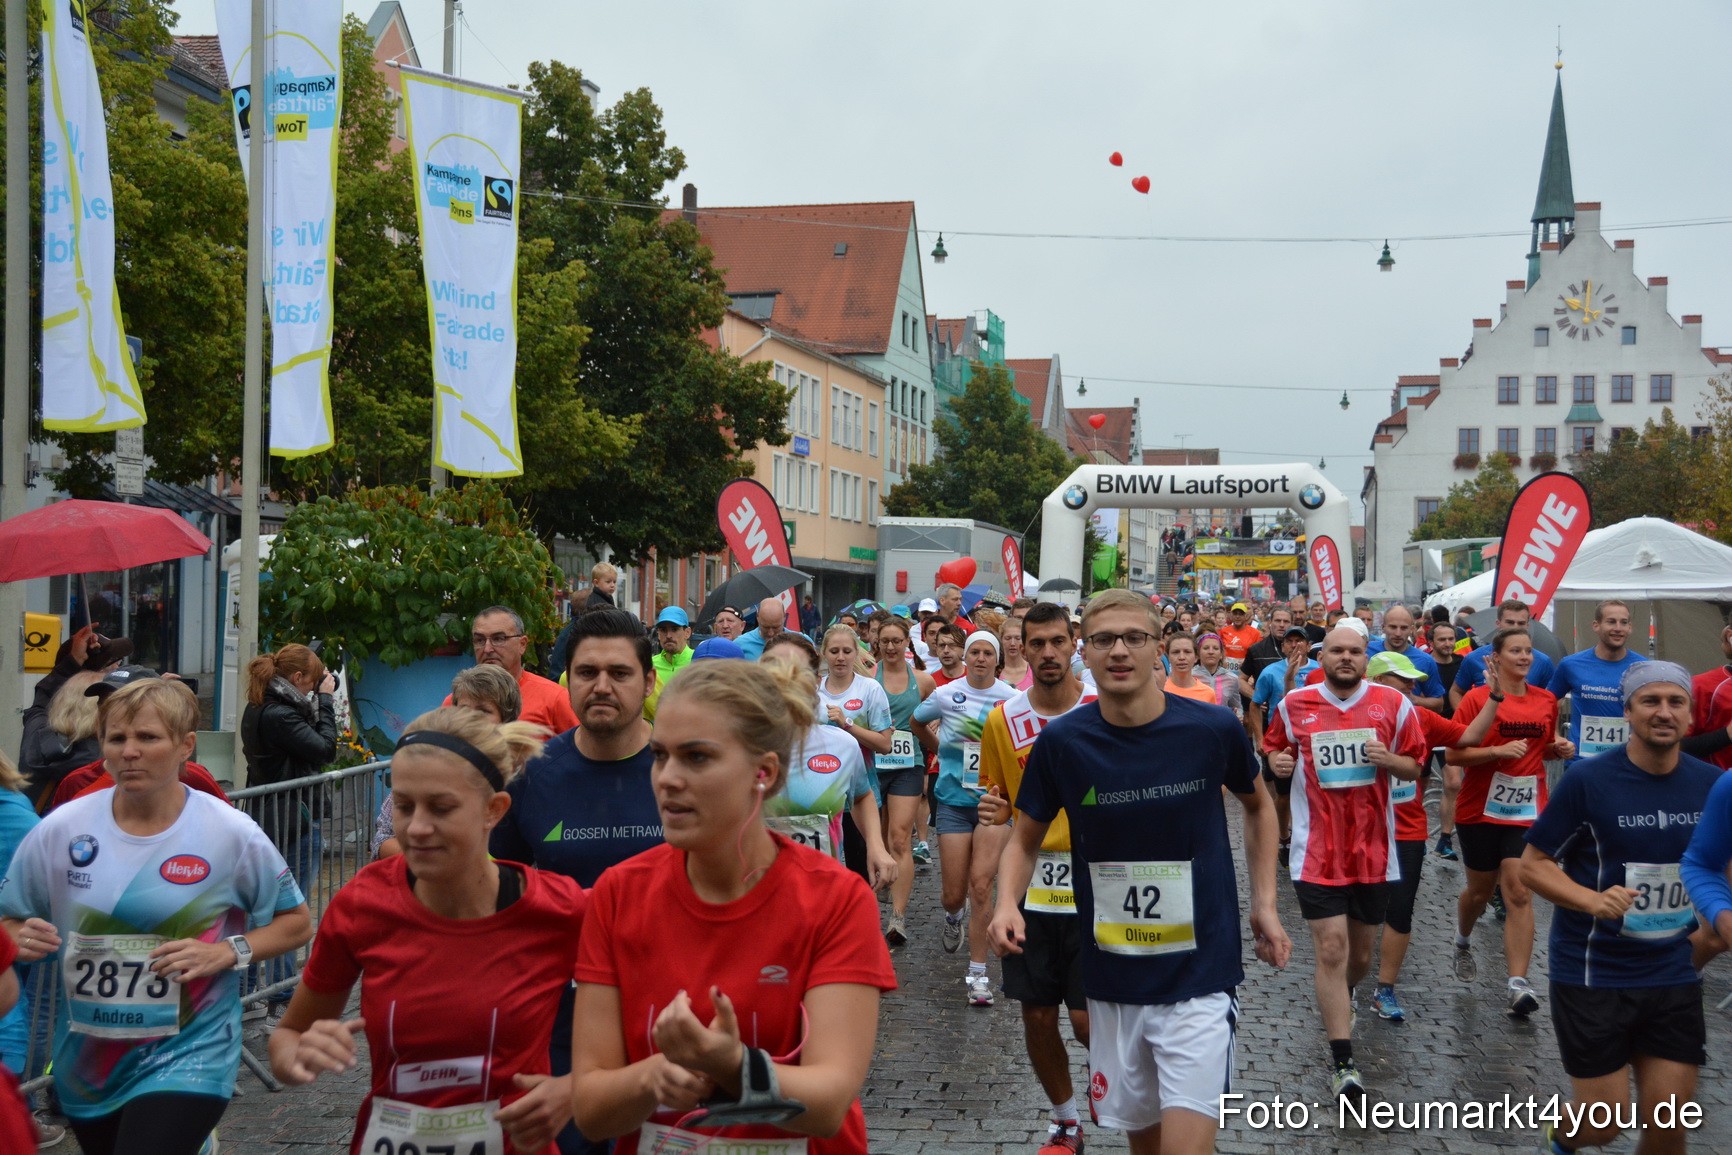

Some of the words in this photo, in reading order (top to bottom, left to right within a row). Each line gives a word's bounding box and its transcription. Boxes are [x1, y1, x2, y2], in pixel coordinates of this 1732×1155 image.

[1096, 473, 1163, 494] BMW
[1169, 473, 1290, 498] Laufsport
[1501, 492, 1578, 606] REWE
[1235, 558, 1258, 568] ZIEL
[1315, 544, 1339, 606] REWE
[1581, 692, 1619, 702] Pettenhofen
[1586, 726, 1623, 742] 2141
[812, 759, 838, 769] Hervis
[880, 757, 904, 765] Rebecca
[1097, 789, 1140, 805] GOSSEN
[1142, 778, 1207, 800] METRAWATT
[1493, 784, 1533, 804] 2754
[1617, 814, 1656, 828] EURO
[1669, 811, 1704, 825] POLE
[563, 827, 609, 841] GOSSEN
[612, 825, 666, 838] METRAW
[166, 861, 205, 877] Hervis
[1042, 862, 1070, 887] 32
[1132, 865, 1182, 877] BOCK
[1122, 885, 1162, 919] 42
[1125, 927, 1162, 942] Oliver
[113, 939, 158, 951] BOC
[75, 959, 170, 999] 2873
[93, 1008, 145, 1025] Andrea
[419, 1067, 459, 1082] DEHN
[416, 1108, 488, 1131] BOCK
